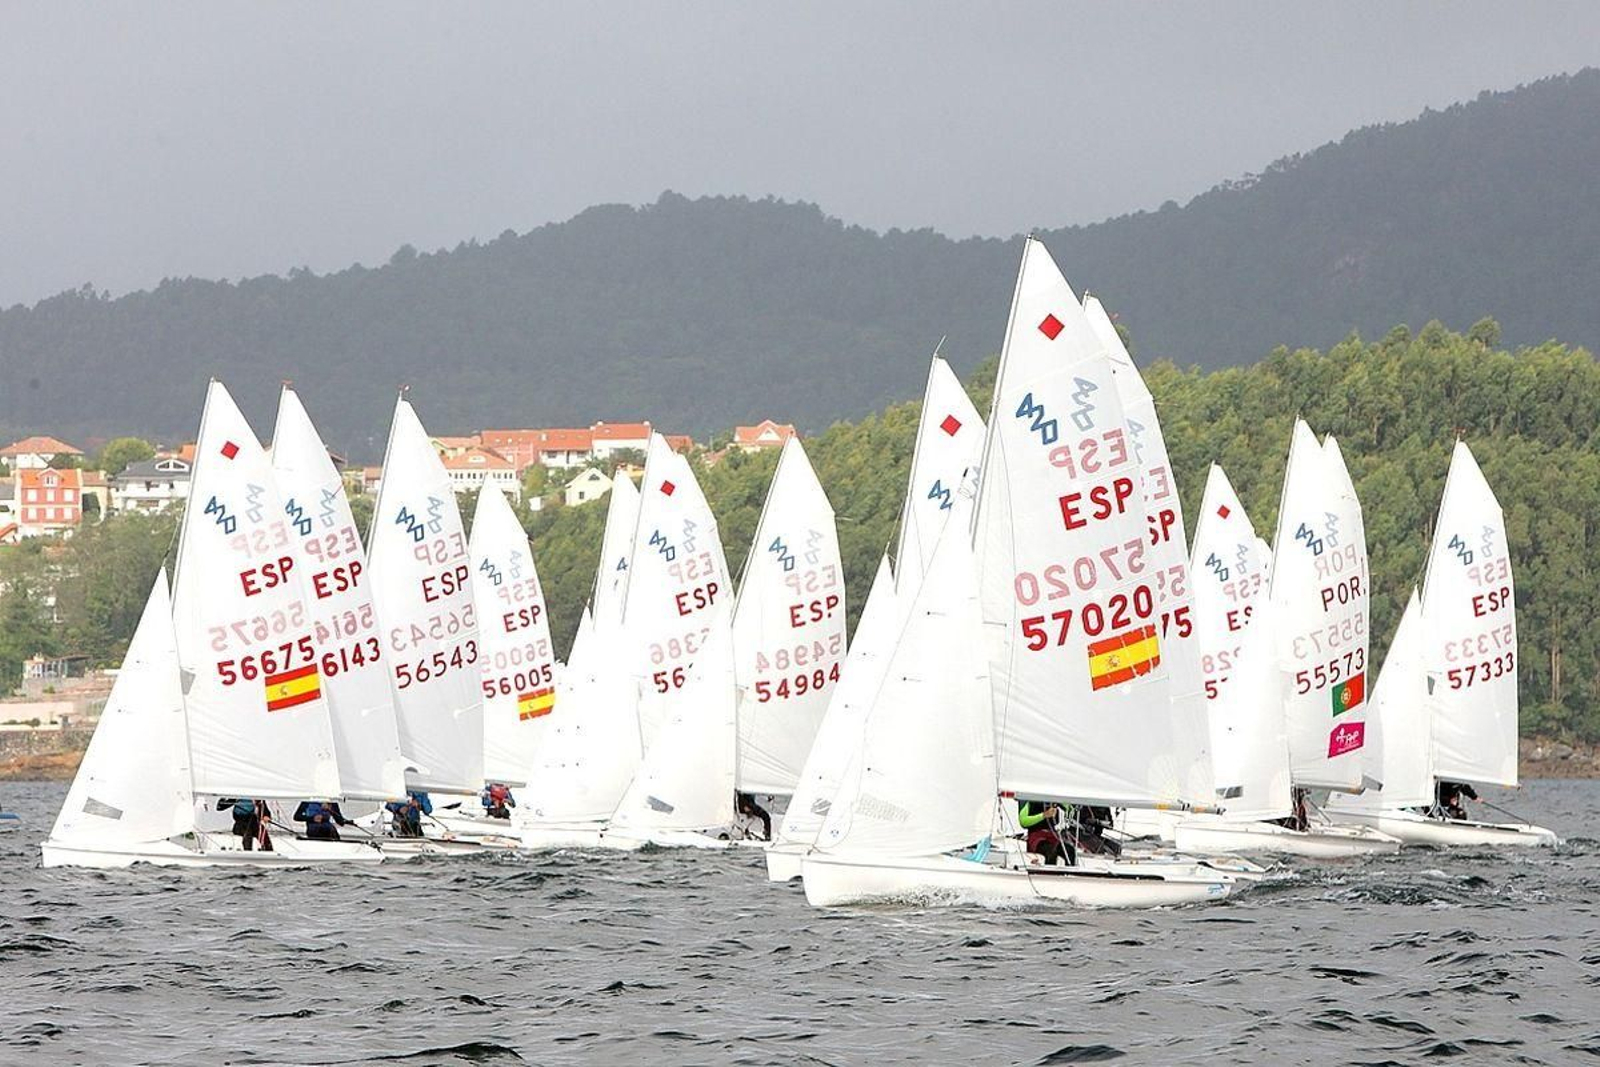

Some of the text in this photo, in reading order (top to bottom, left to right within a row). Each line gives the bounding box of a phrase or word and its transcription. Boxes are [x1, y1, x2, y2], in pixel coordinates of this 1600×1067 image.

[1016, 392, 1058, 446] 420
[928, 480, 953, 511] 42
[1059, 476, 1134, 531] ESP
[204, 496, 236, 534] 420
[285, 498, 312, 536] 420
[394, 506, 425, 542] 420
[1147, 509, 1176, 546] SP
[649, 529, 676, 562] 420
[768, 536, 795, 572] 420
[1295, 522, 1323, 556] 420
[1448, 534, 1474, 566] 420
[240, 556, 293, 597] ESP
[312, 560, 362, 600] ESP
[422, 565, 470, 603] ESP
[480, 558, 502, 586] 420
[1205, 552, 1229, 582] 420
[675, 582, 718, 616] ESP
[788, 594, 840, 628] ESP
[1472, 586, 1510, 618] ESP
[503, 604, 541, 633] ESP
[1021, 584, 1153, 652] 57020
[1226, 605, 1253, 632] ES
[217, 636, 315, 686] 56675
[322, 637, 380, 678] 6143
[395, 639, 479, 689] 56543
[1296, 647, 1365, 695] 55573
[1447, 652, 1514, 690] 57333
[482, 663, 552, 699] 56005
[755, 662, 841, 703] 54984
